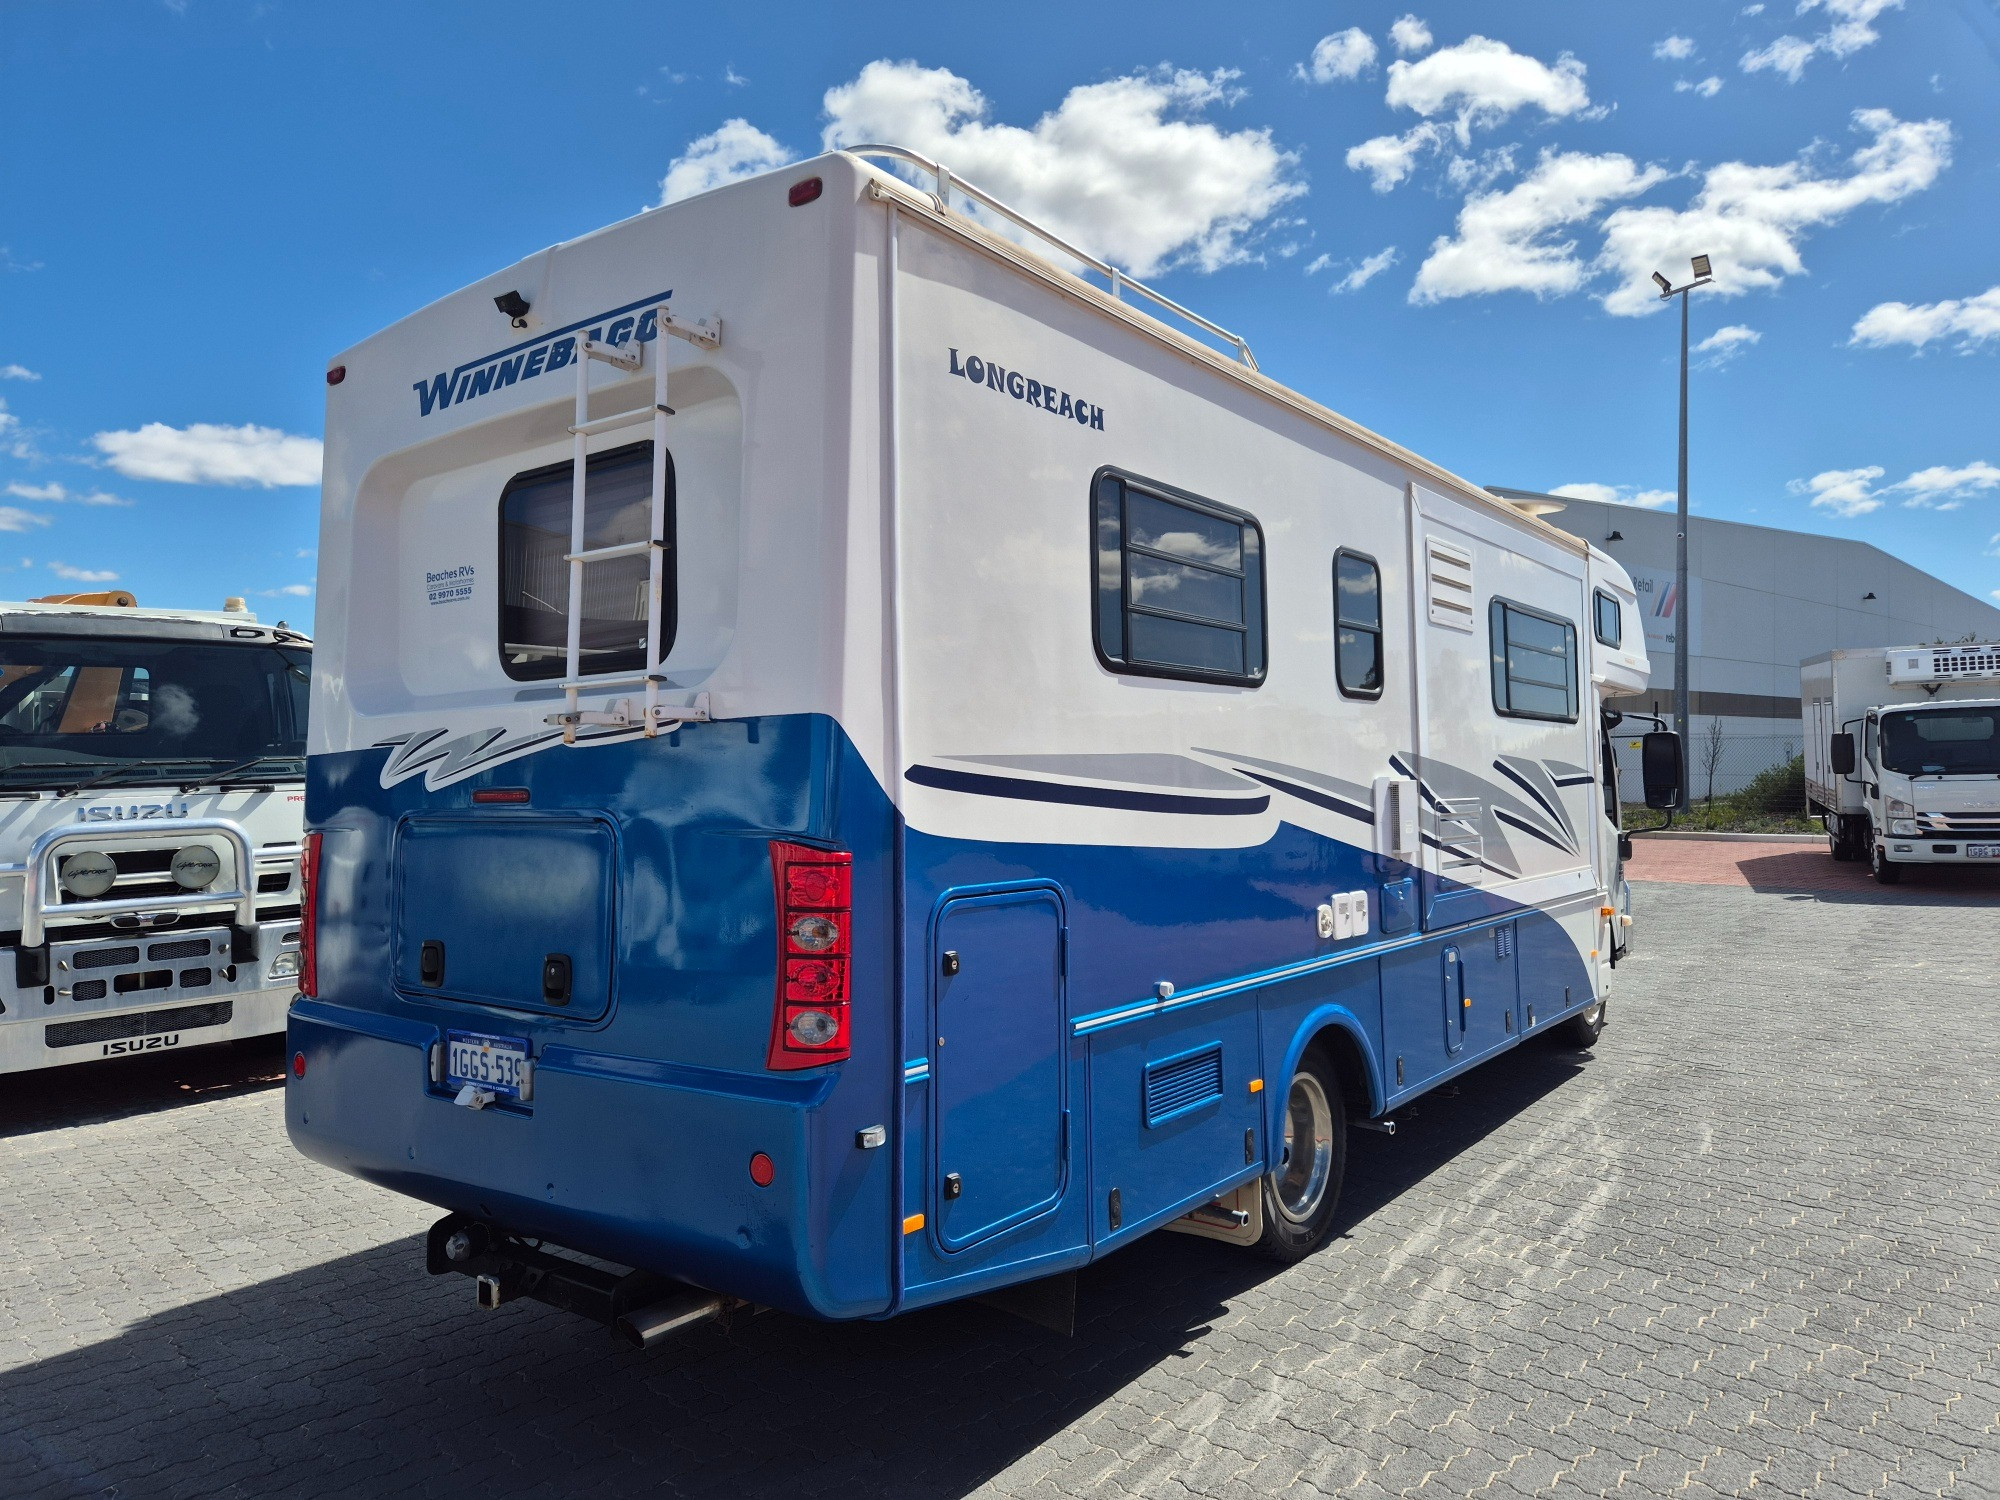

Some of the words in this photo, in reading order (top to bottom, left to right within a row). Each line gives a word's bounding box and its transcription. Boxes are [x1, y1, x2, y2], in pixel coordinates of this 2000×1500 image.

[947, 347, 1105, 432] LONGREACH
[427, 569, 458, 583] Beaches
[458, 565, 475, 577] RVs
[1633, 576, 1653, 593] Retail
[429, 593, 437, 601] 02
[438, 590, 454, 599] 9970
[455, 587, 472, 596] 5555
[78, 803, 188, 822] ISUZU
[103, 1034, 179, 1056] ISUZU
